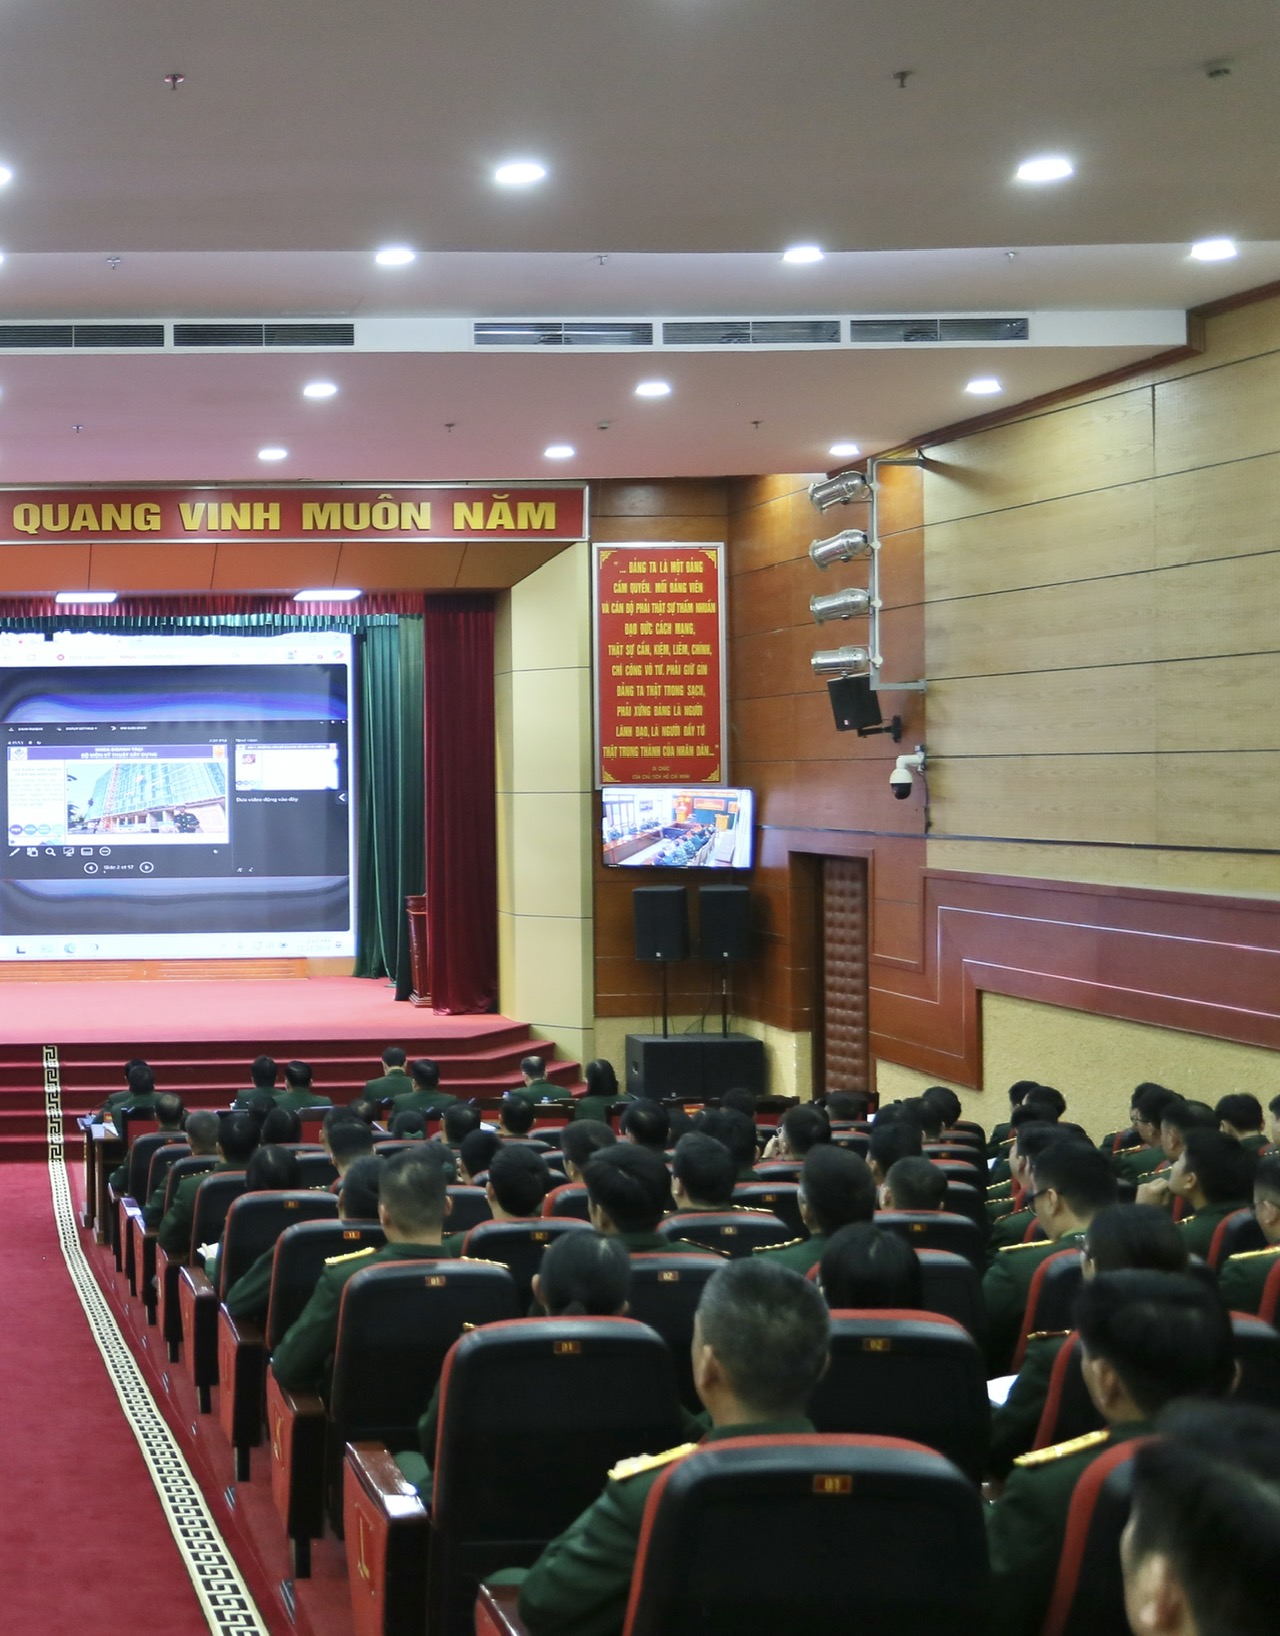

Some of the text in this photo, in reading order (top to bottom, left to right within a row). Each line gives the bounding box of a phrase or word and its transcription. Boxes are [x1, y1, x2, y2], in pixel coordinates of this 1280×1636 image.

[13, 503, 161, 535] QUANG
[179, 502, 281, 531] VINH
[302, 494, 432, 531] MUÔN
[453, 494, 556, 530] NĂM
[431, 1278, 439, 1286] 01
[561, 1342, 572, 1352] 01
[870, 1339, 882, 1349] 02
[825, 1479, 839, 1491] 01
